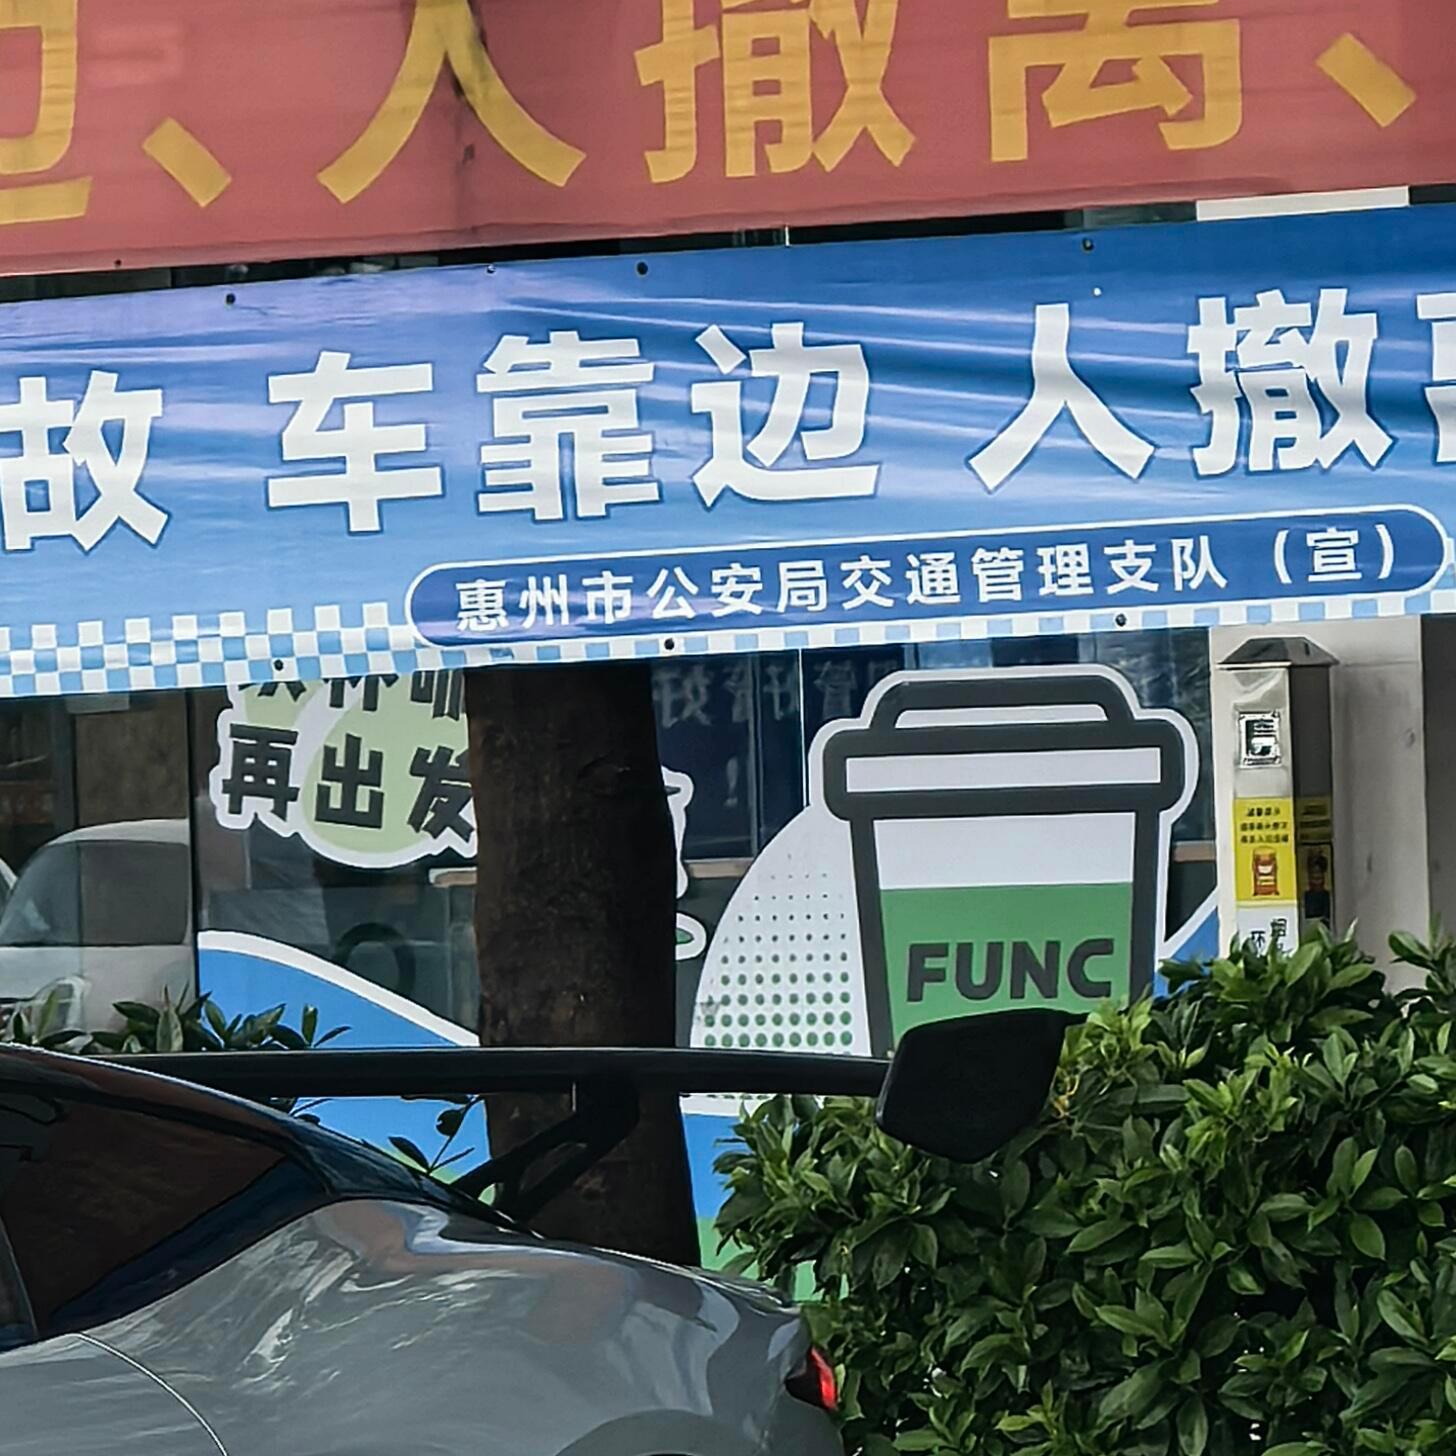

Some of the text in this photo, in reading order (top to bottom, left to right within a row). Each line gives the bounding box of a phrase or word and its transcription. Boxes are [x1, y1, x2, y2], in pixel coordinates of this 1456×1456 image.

[267, 321, 881, 534] 车靠边
[967, 287, 1456, 493] 人撤
[454, 523, 1395, 633] 惠州市公安局交通管理支队（宣）
[222, 722, 476, 843] 再出发
[906, 938, 1114, 1002] FUNC
